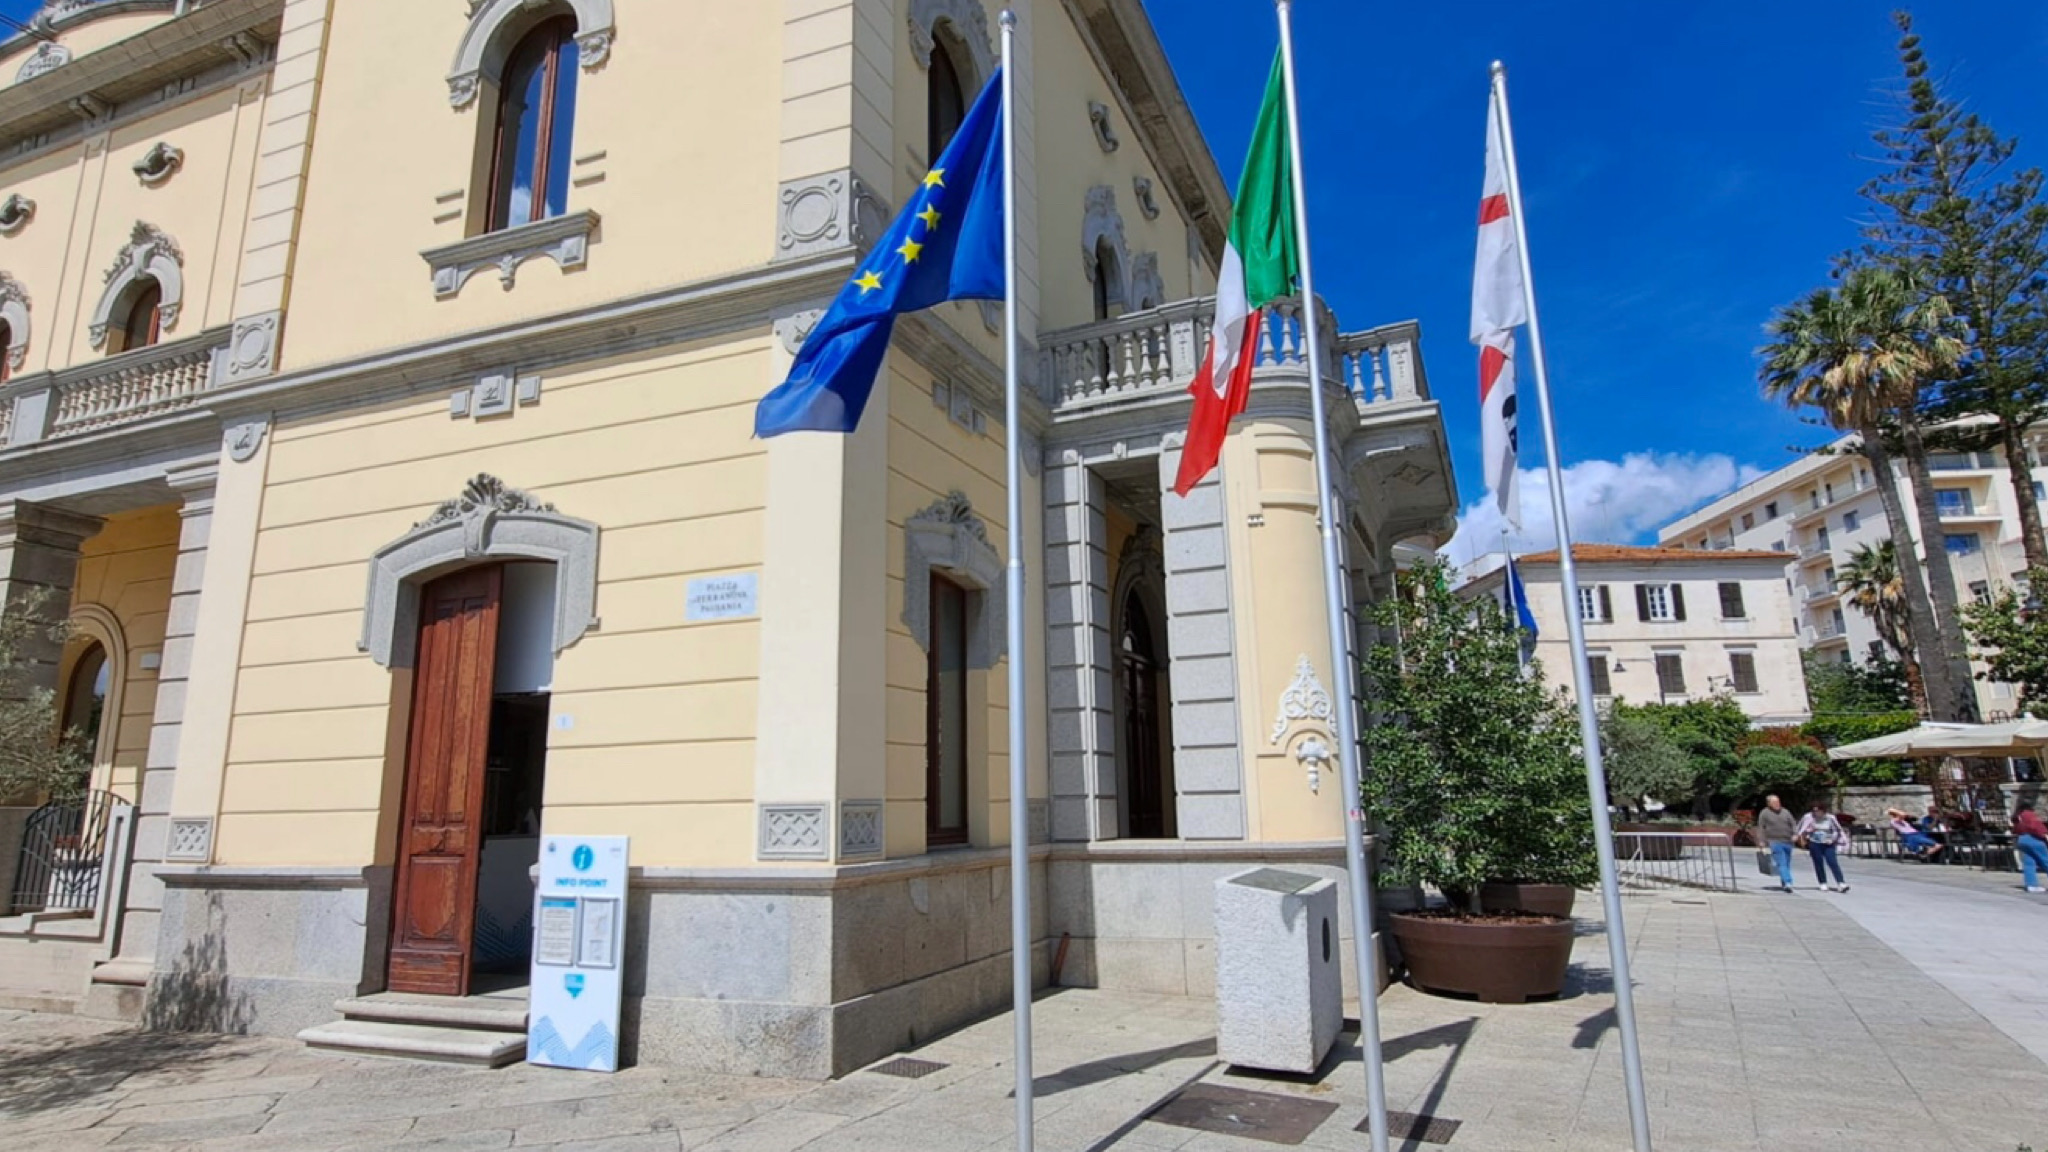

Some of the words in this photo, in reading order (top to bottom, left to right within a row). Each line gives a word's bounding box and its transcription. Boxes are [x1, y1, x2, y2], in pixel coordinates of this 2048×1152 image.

[707, 581, 738, 592] PIAZZA
[556, 878, 577, 888] INFO
[579, 878, 608, 888] POINT
